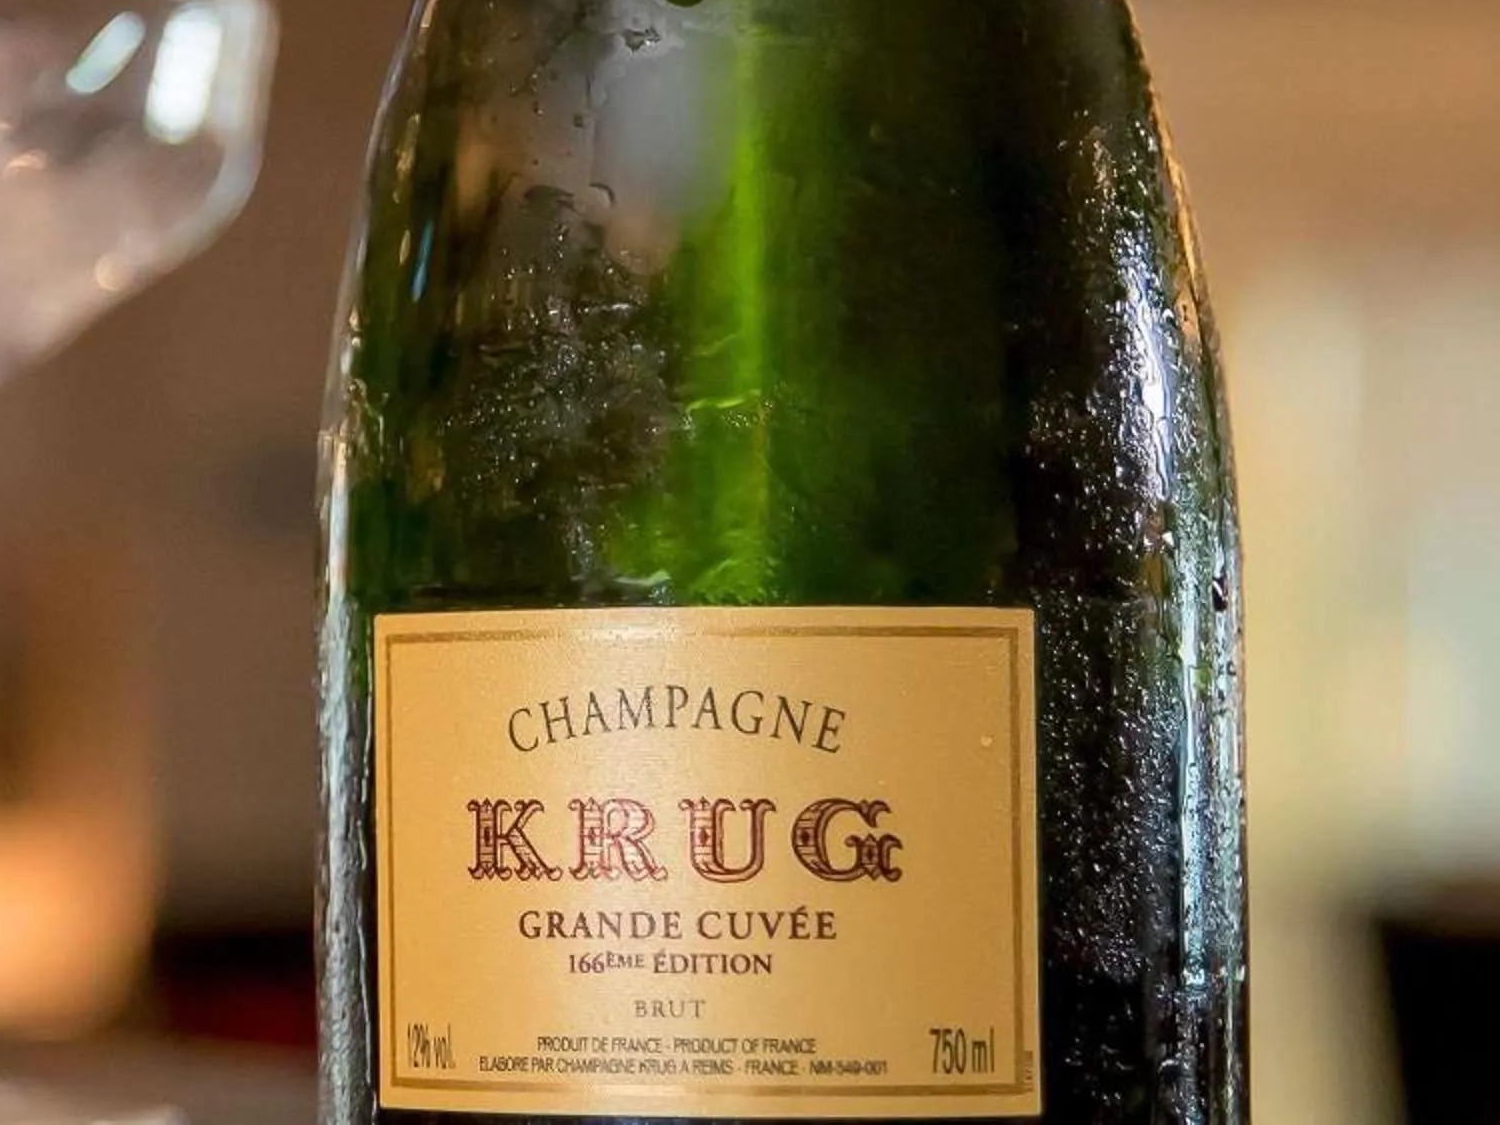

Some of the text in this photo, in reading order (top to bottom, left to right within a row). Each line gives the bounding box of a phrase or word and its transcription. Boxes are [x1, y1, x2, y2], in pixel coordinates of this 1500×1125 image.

[508, 684, 847, 754] CHAMPAGNE
[466, 796, 903, 883] KRUG
[518, 906, 837, 940] GRANDE CUVÉE
[652, 948, 773, 974] ÉDITION
[635, 999, 707, 1018] BRUT
[406, 1023, 431, 1069] 12%
[537, 1036, 589, 1053] PRODUIT
[591, 1037, 608, 1053] DE
[611, 1037, 662, 1053] FRANCE
[673, 1037, 737, 1053] PRODUCT
[741, 1038, 759, 1054] OF
[762, 1038, 816, 1054] FRANCE
[929, 1027, 967, 1075] 750
[971, 1025, 995, 1074] ml
[531, 1057, 554, 1072] PAR
[557, 1058, 636, 1074] CHAMPAGNE
[639, 1059, 676, 1075] KRUG
[692, 1059, 733, 1075] REIMS
[744, 1059, 798, 1075] FRANCE
